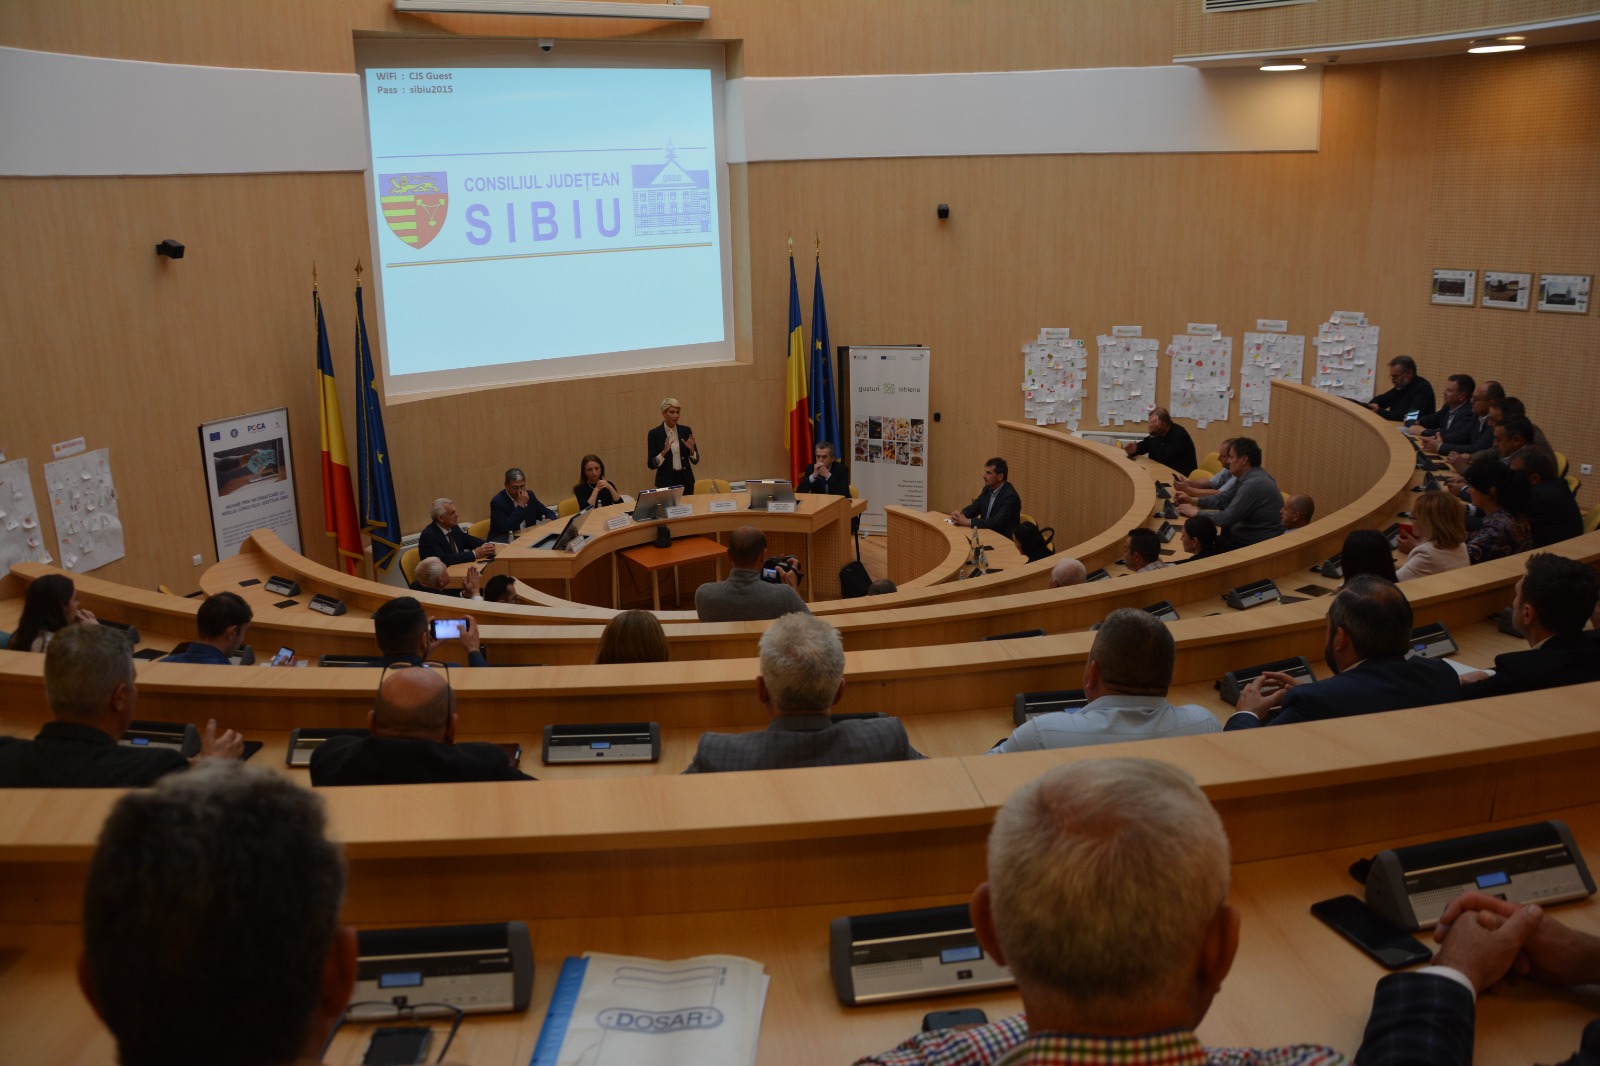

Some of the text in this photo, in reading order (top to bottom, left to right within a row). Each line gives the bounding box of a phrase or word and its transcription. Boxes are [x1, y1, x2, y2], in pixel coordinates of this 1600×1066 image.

[375, 72, 397, 81] WiFi
[409, 72, 424, 80] CJS
[426, 72, 453, 80] Guest
[377, 86, 398, 94] Pass
[410, 85, 453, 94] sibiu2015
[464, 172, 620, 192] CONSILIUL JUDEȚEAN
[465, 197, 621, 246] SIBIU
[858, 384, 880, 393] gusturi
[247, 422, 266, 433] POCA
[615, 1011, 704, 1030] DOSAR
